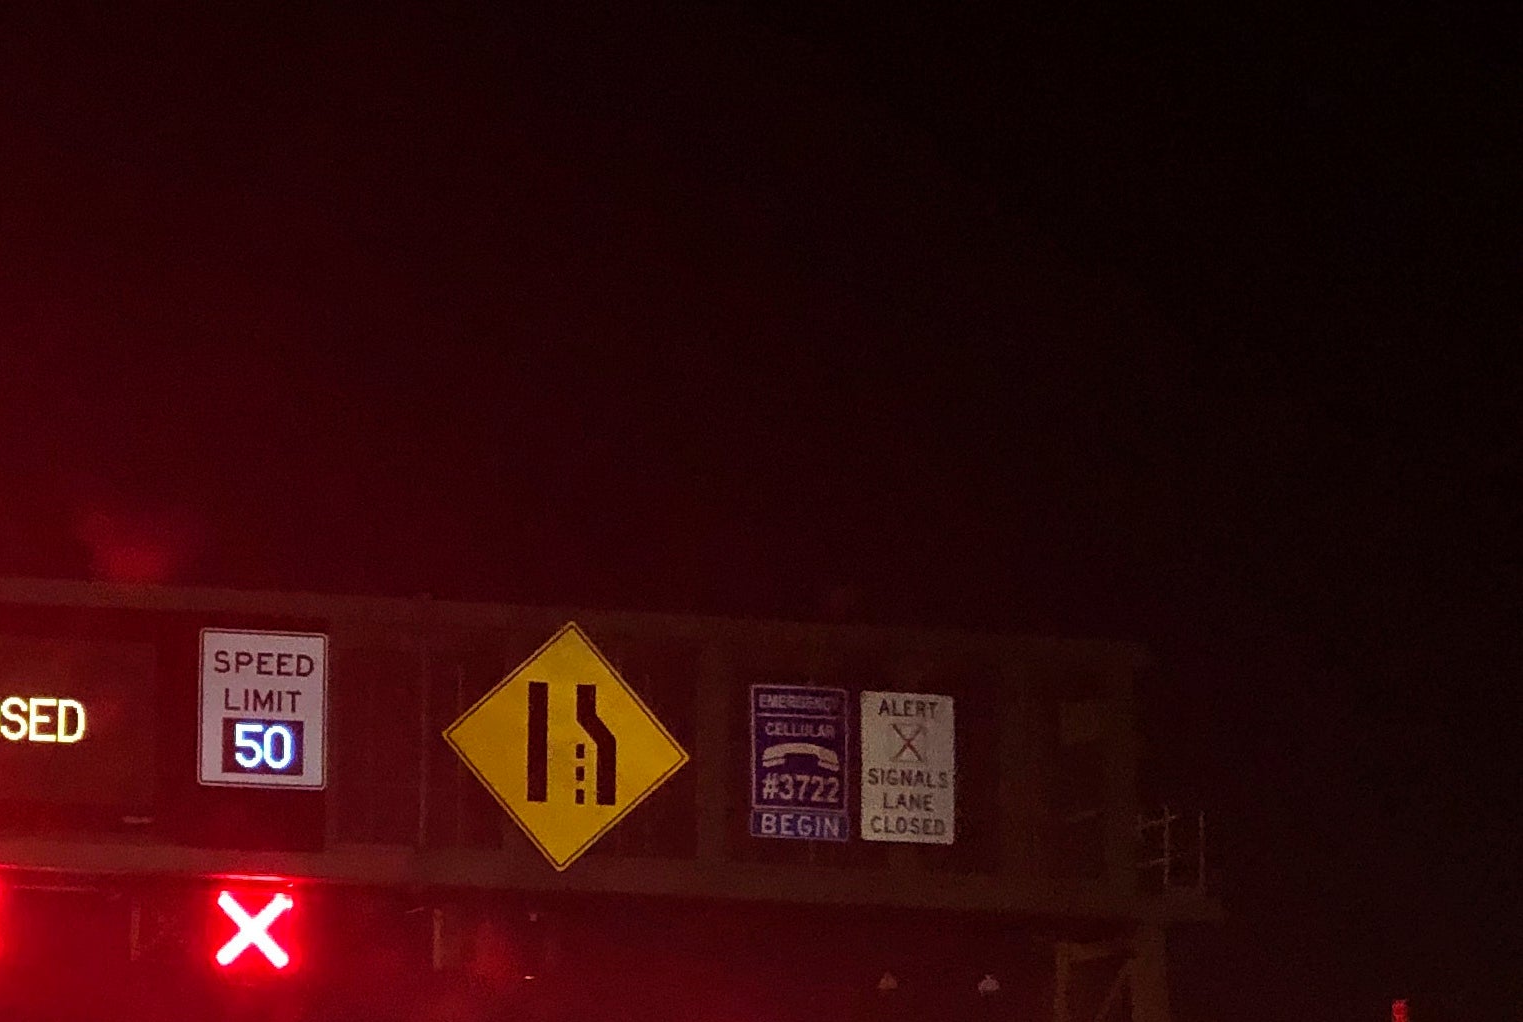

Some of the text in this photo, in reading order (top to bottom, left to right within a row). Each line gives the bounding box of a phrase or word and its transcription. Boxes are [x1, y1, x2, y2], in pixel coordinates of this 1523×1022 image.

[213, 649, 315, 678] SPEED
[224, 687, 303, 714] LIMIT
[877, 698, 939, 719] ALERT
[764, 721, 836, 739] CELLULAR
[234, 722, 293, 770] 50
[762, 772, 840, 804] #3722
[867, 767, 950, 790] SIGNALS
[882, 792, 935, 813] LANE
[760, 812, 840, 838] BEGIN
[869, 815, 947, 837] CLOSED
